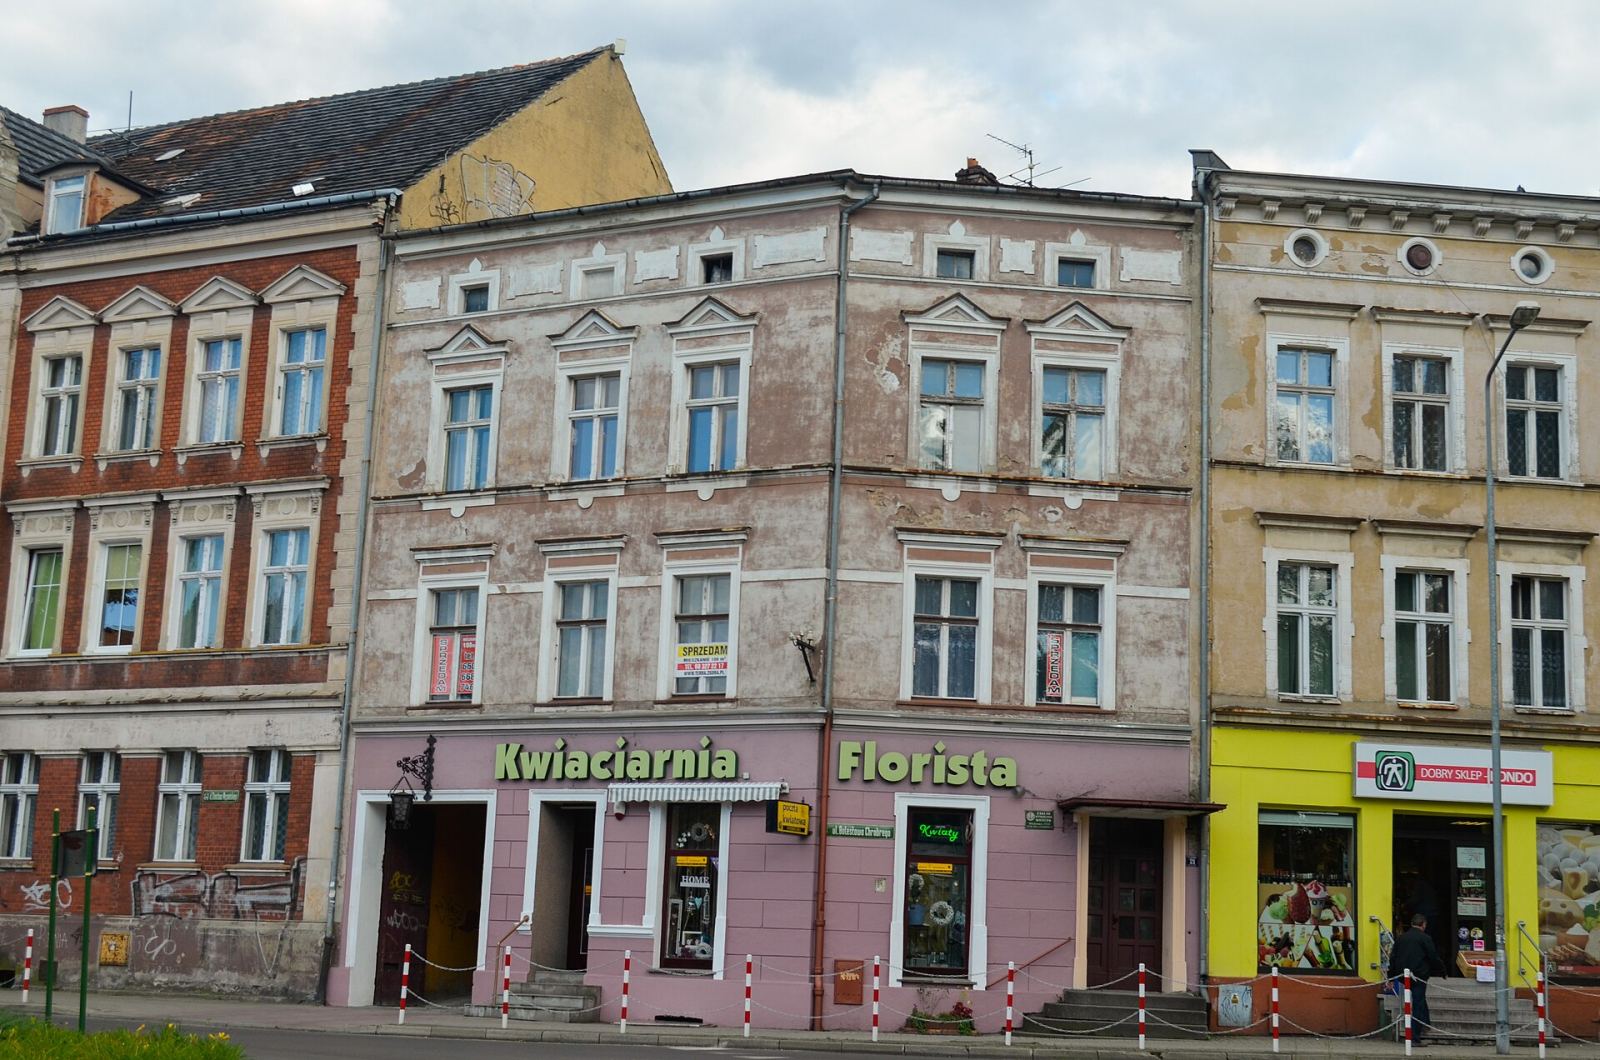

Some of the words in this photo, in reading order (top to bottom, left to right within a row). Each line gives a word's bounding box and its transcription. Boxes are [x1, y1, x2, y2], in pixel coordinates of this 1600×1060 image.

[436, 639, 449, 692] SPRZEDAM
[682, 645, 728, 656] SPRZEDAM
[1048, 638, 1060, 693] SPRZEDAM
[495, 736, 737, 780] Kwiaciarnia
[838, 740, 1017, 787] Florista
[1420, 767, 1453, 779] DOBRY
[1455, 769, 1482, 780] SKLEP
[1490, 769, 1534, 784] ONDO
[919, 824, 959, 842] Kwiaty
[681, 875, 710, 884] HOME
